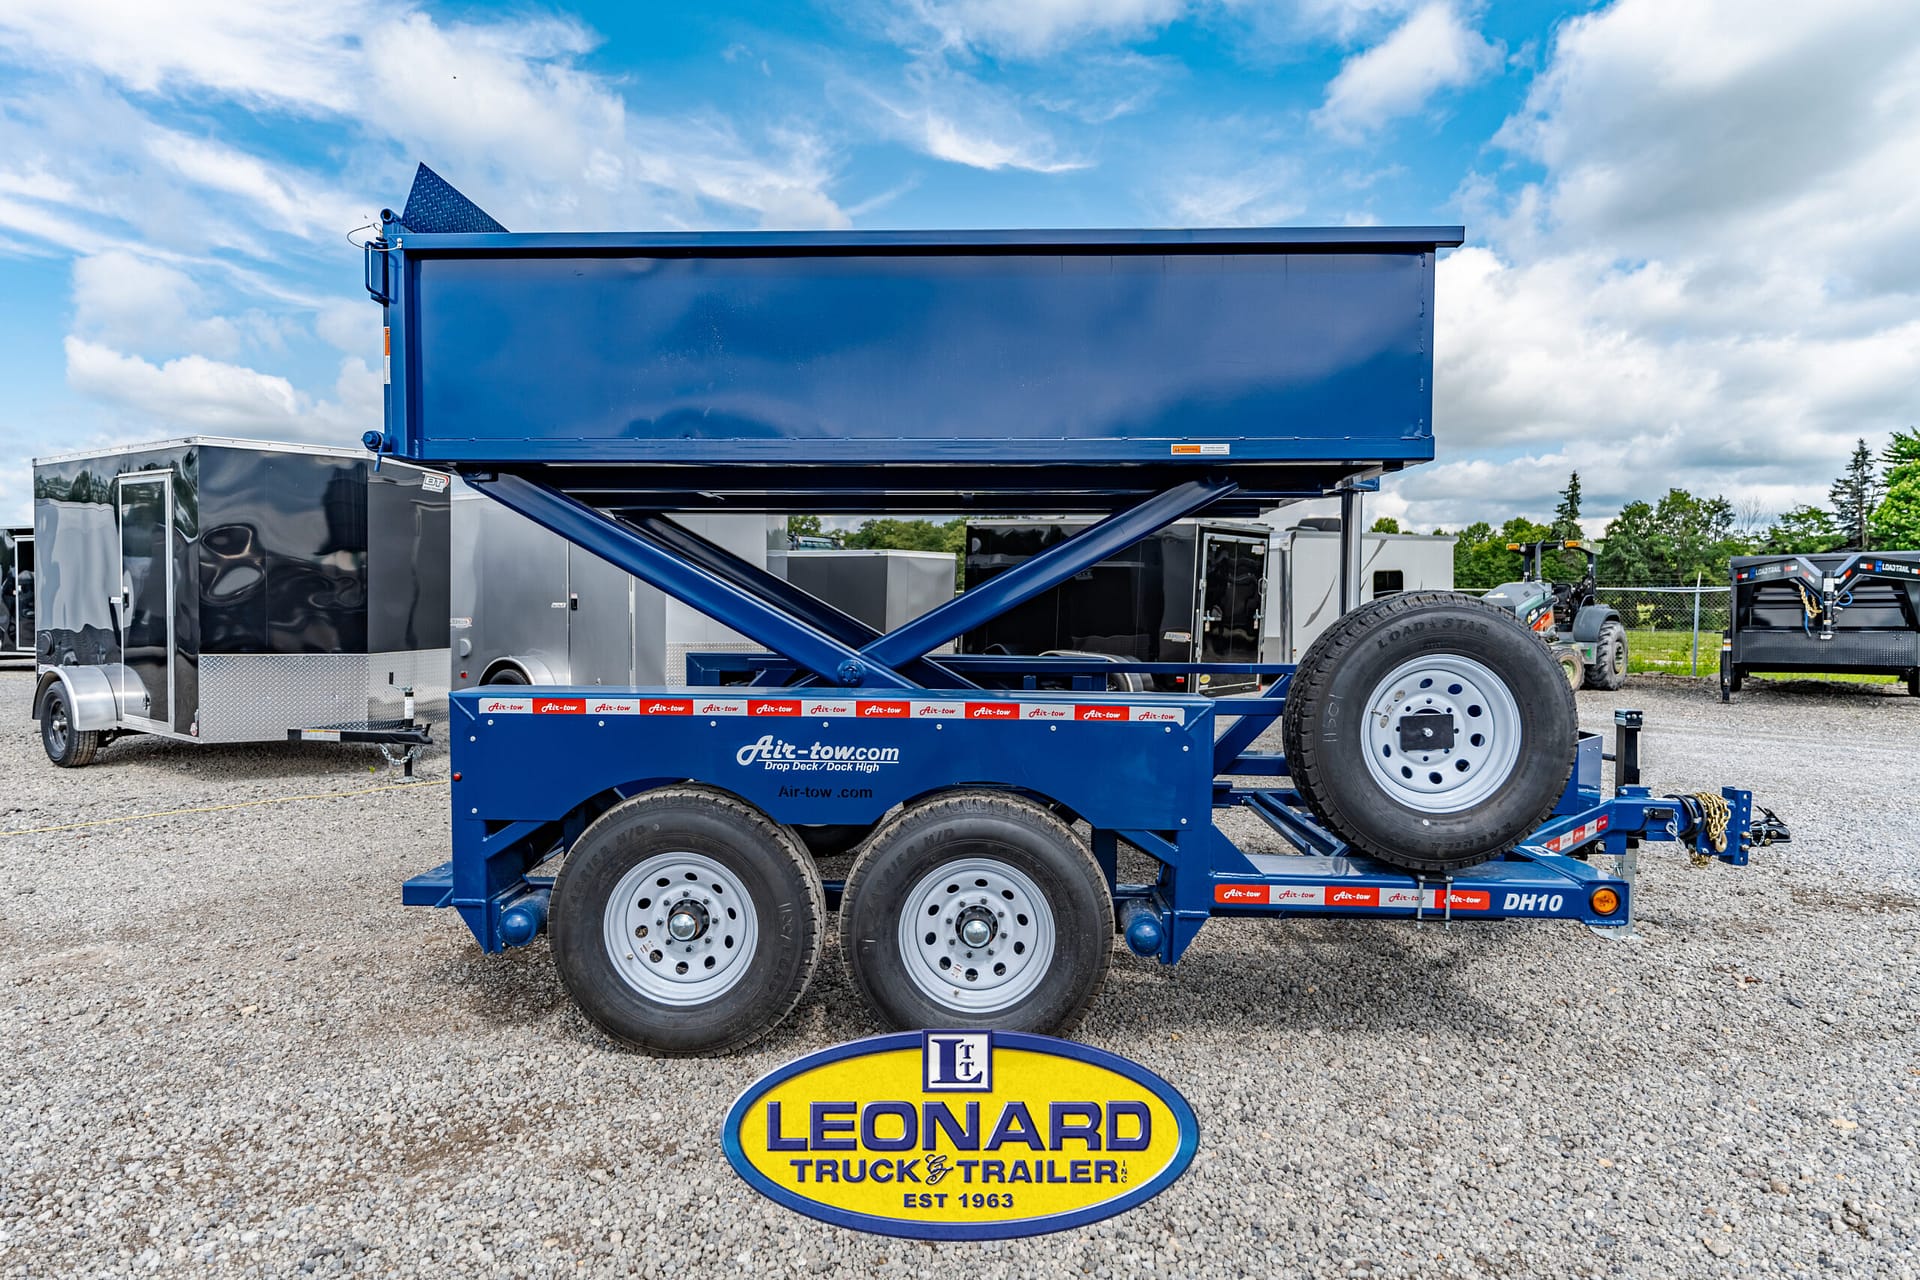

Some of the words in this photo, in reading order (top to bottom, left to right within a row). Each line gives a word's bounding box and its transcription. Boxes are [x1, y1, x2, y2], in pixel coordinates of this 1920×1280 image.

[488, 701, 524, 712] Air-tow
[540, 702, 578, 713] Air-tow
[594, 702, 631, 713] Air-tow
[648, 703, 685, 714] Air-tow
[701, 703, 738, 714] Air-tow
[756, 703, 793, 714] Air-tow
[810, 704, 847, 715] Air-tow
[864, 705, 902, 716] Air-tow
[919, 705, 956, 716] Air-tow
[973, 706, 1011, 717] Air-tow
[1028, 707, 1065, 718] Air-tow
[1083, 708, 1121, 720] Air-tow
[1137, 710, 1175, 721] Air-tow
[736, 735, 900, 766] Air-tow.com
[764, 761, 790, 772] Drop
[855, 762, 880, 774] High
[778, 785, 833, 798] Air-tow
[1223, 888, 1261, 899] Air-tow
[1279, 889, 1315, 899] Air-tow
[1333, 891, 1371, 902] Air-tow
[1503, 893, 1565, 912] DH10
